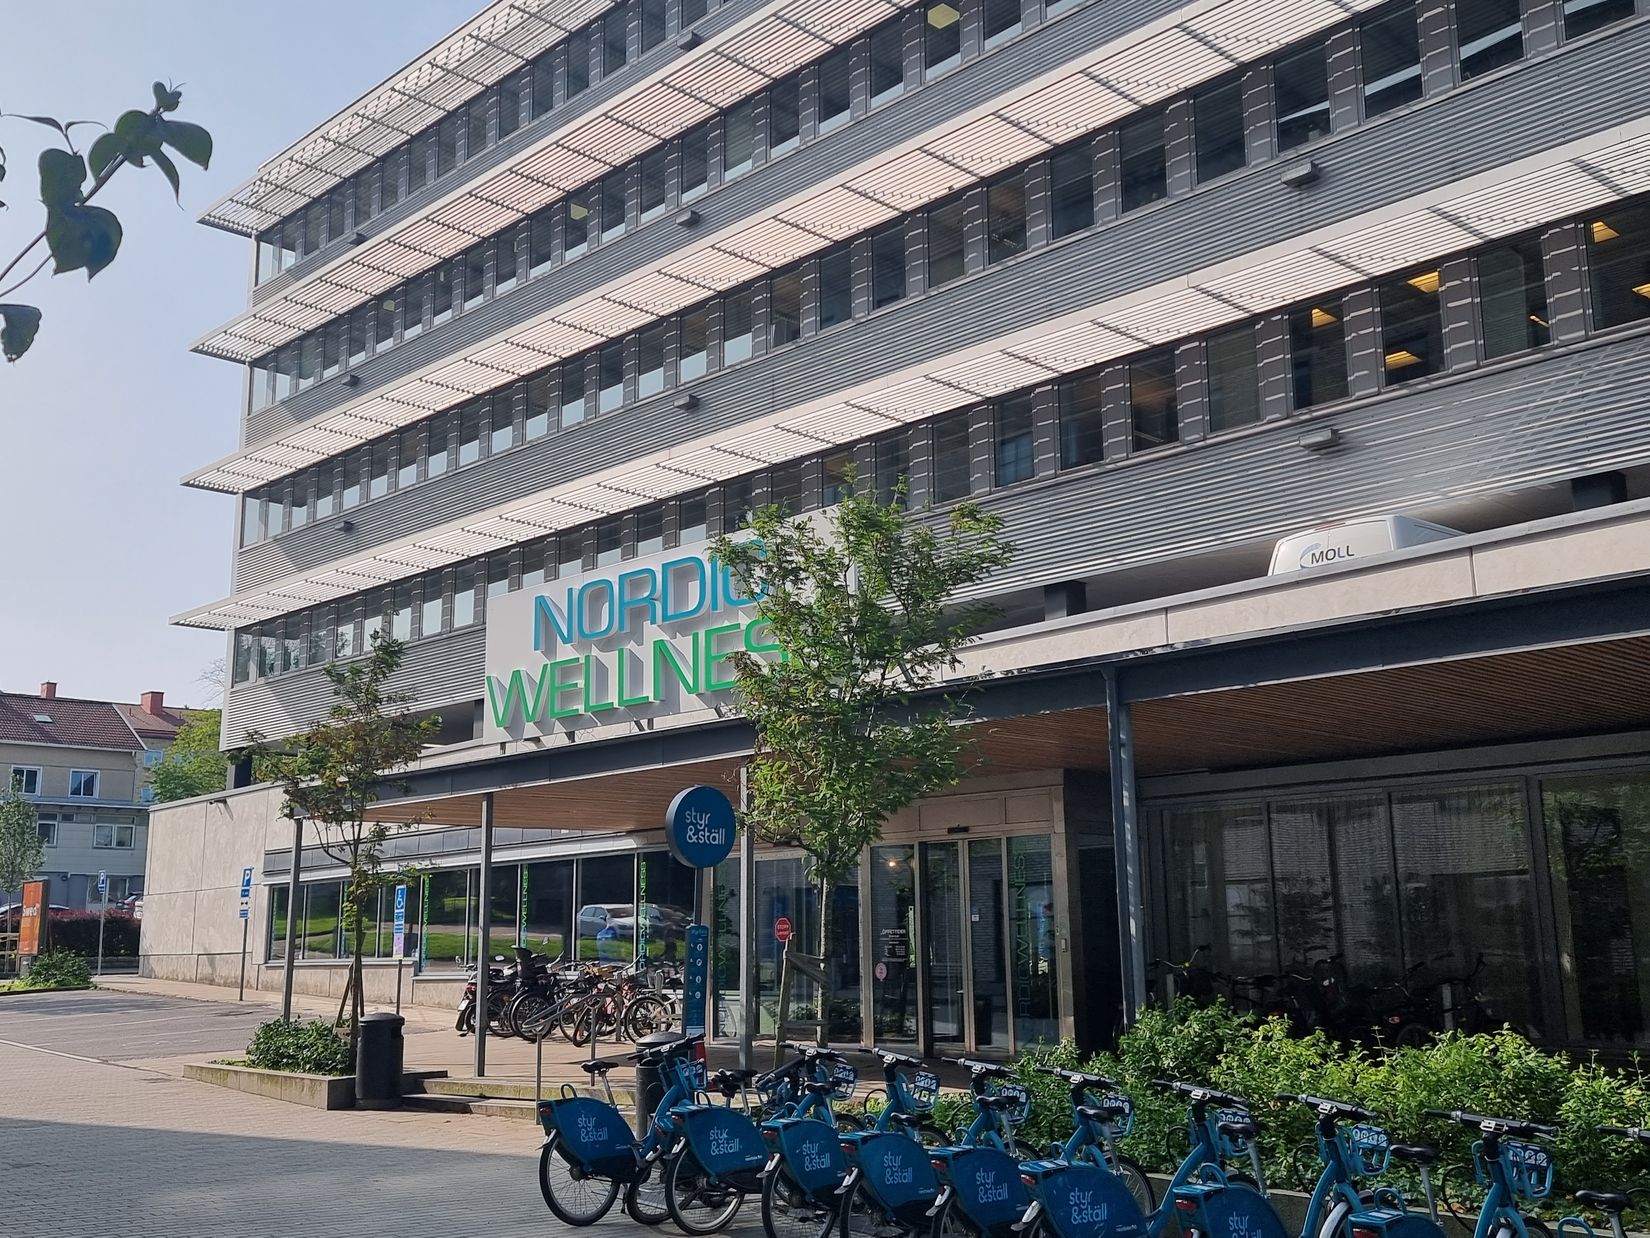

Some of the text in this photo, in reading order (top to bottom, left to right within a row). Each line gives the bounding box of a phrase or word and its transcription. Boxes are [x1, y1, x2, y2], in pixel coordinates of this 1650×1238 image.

[1311, 545, 1355, 565] MOLL
[534, 538, 770, 651] NORDIC
[486, 615, 790, 728] WELLNES
[685, 807, 711, 829] styr
[686, 825, 725, 845] &ställ
[244, 870, 251, 886] P
[577, 1113, 597, 1131] styr
[580, 1127, 608, 1143] &ställ
[709, 1126, 729, 1143] styr
[710, 1138, 739, 1156] &ställ
[802, 1140, 820, 1158] styr
[804, 1153, 830, 1171] &ställ
[883, 1152, 901, 1171] styr
[885, 1167, 913, 1185] &ställ
[976, 1168, 996, 1188] styr
[978, 1183, 1008, 1203] &ställ
[1069, 1187, 1093, 1208] styr
[1071, 1203, 1107, 1225] &ställ
[1228, 1211, 1249, 1236] styr
